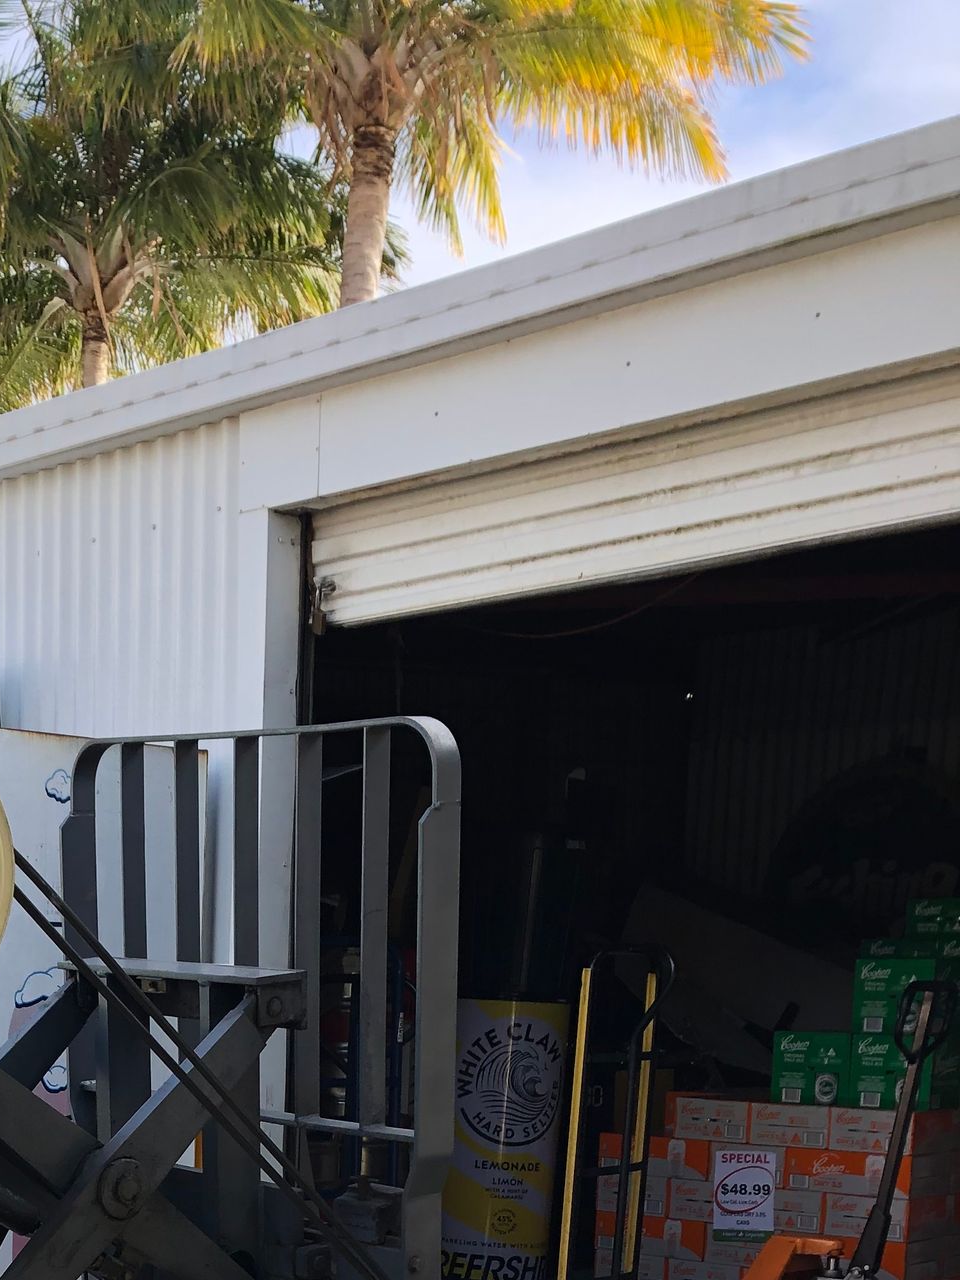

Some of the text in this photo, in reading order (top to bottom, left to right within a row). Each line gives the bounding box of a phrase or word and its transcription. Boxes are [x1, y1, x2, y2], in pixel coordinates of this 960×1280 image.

[457, 1022, 561, 1099] WHITE CLAW
[472, 1080, 559, 1139] HARD SELTZER
[721, 1153, 770, 1164] SPECIAL
[474, 1160, 542, 1172] LEMONADE
[721, 1183, 771, 1197] $48.99
[441, 1236, 478, 1247] PARKLING
